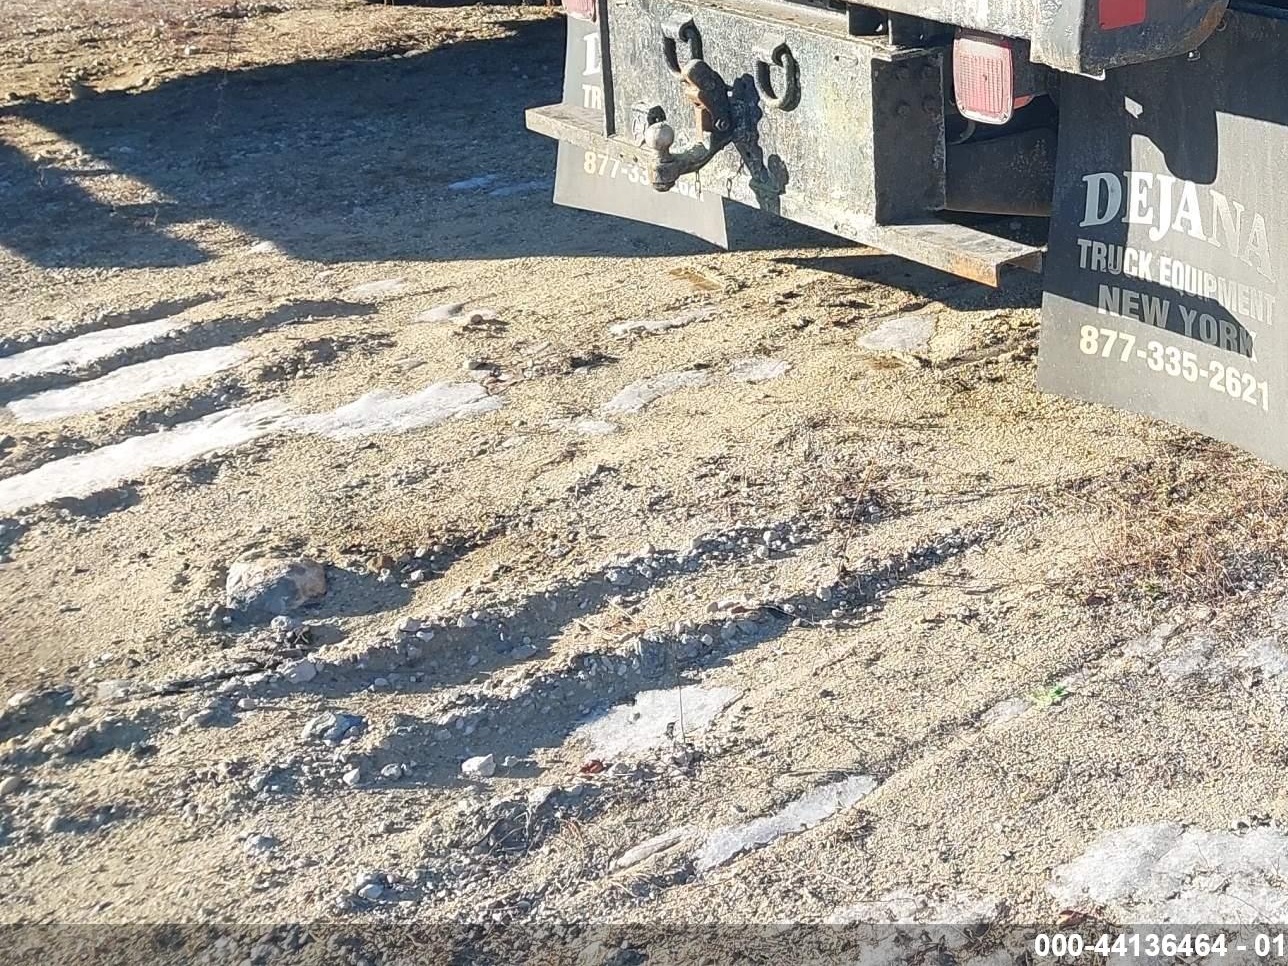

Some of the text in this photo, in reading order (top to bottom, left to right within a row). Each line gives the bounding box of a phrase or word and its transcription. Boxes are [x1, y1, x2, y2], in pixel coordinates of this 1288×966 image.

[1078, 170, 1277, 283] DEJANA
[1077, 238, 1276, 326] TRUCK EQUIPMENT
[1098, 284, 1258, 363] NEW YORK
[1079, 324, 1270, 412] 877-335-2621
